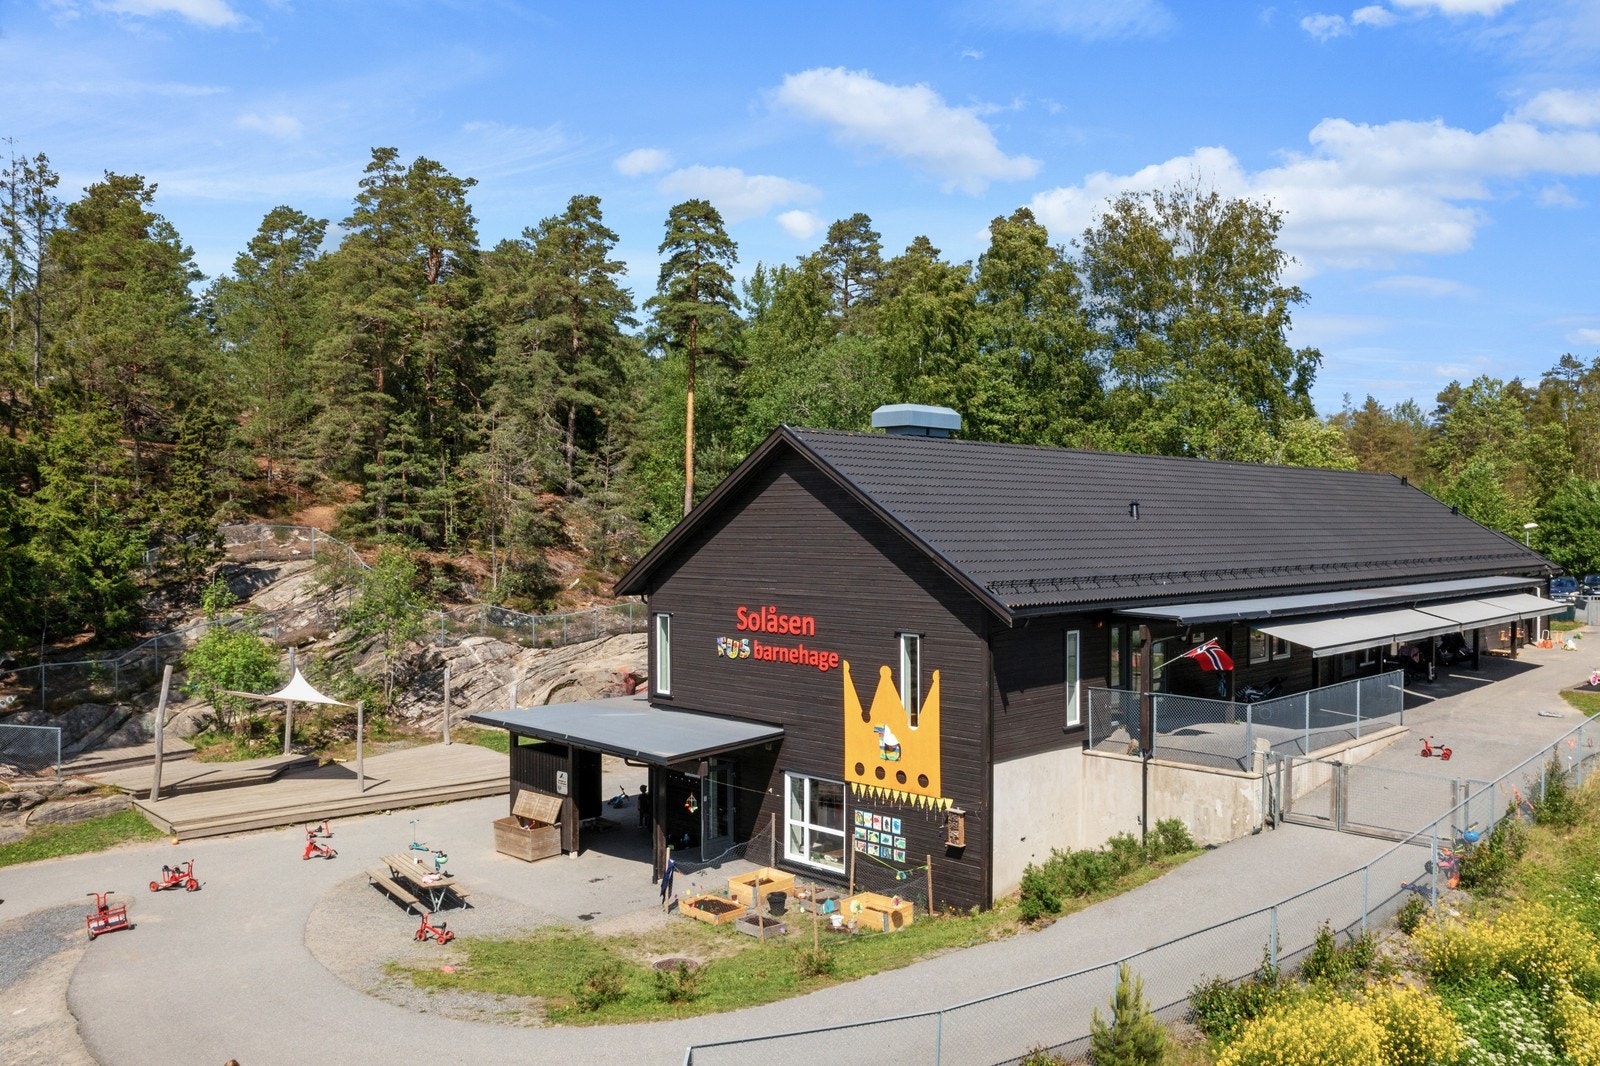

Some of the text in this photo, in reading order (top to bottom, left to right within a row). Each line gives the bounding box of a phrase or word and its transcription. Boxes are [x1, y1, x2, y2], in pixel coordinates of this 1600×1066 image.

[736, 605, 815, 636] Solåsen
[716, 636, 839, 672] FUS barnehage
